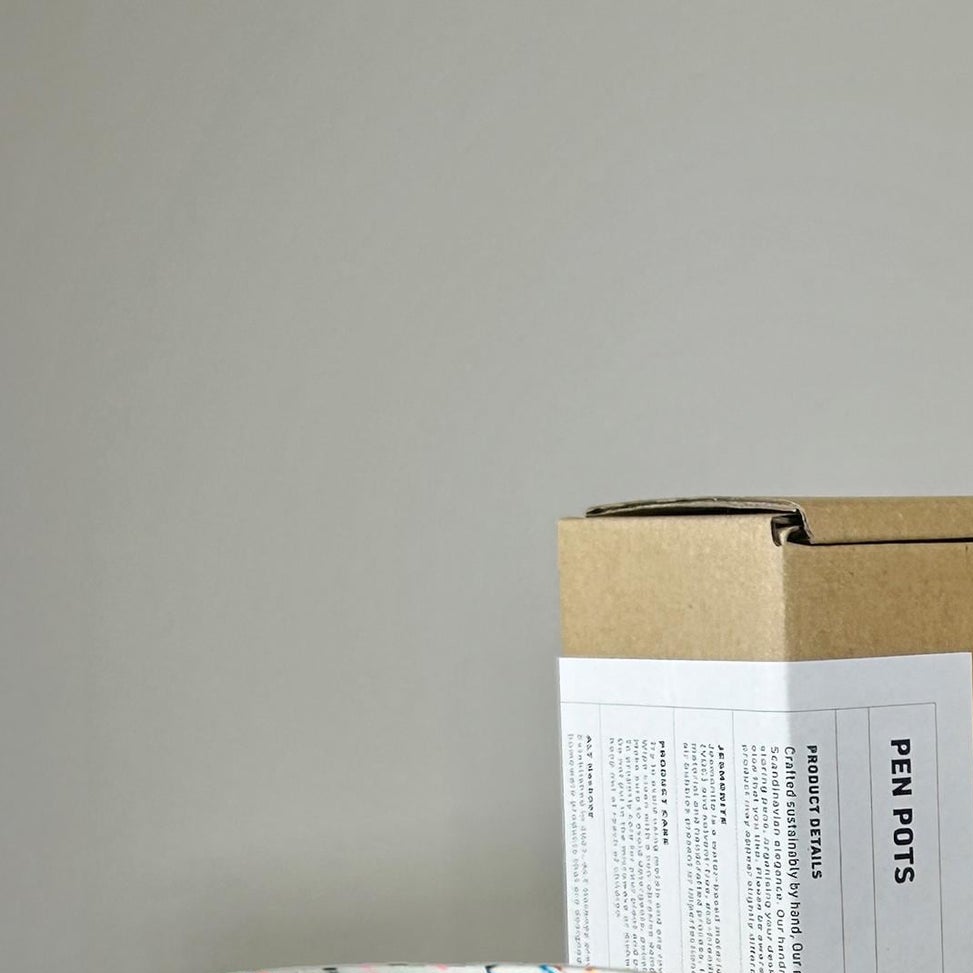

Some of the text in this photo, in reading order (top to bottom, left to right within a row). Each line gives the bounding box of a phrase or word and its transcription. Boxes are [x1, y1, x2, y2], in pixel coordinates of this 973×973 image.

[785, 746, 797, 797] Crafted
[771, 746, 781, 836] Scandinavian
[776, 908, 785, 933] Our
[787, 801, 800, 879] sustainably
[807, 744, 822, 879] PRODUCT DETAILS
[891, 739, 915, 884] PEN POTS
[788, 883, 800, 898] by
[792, 942, 803, 966] Our
